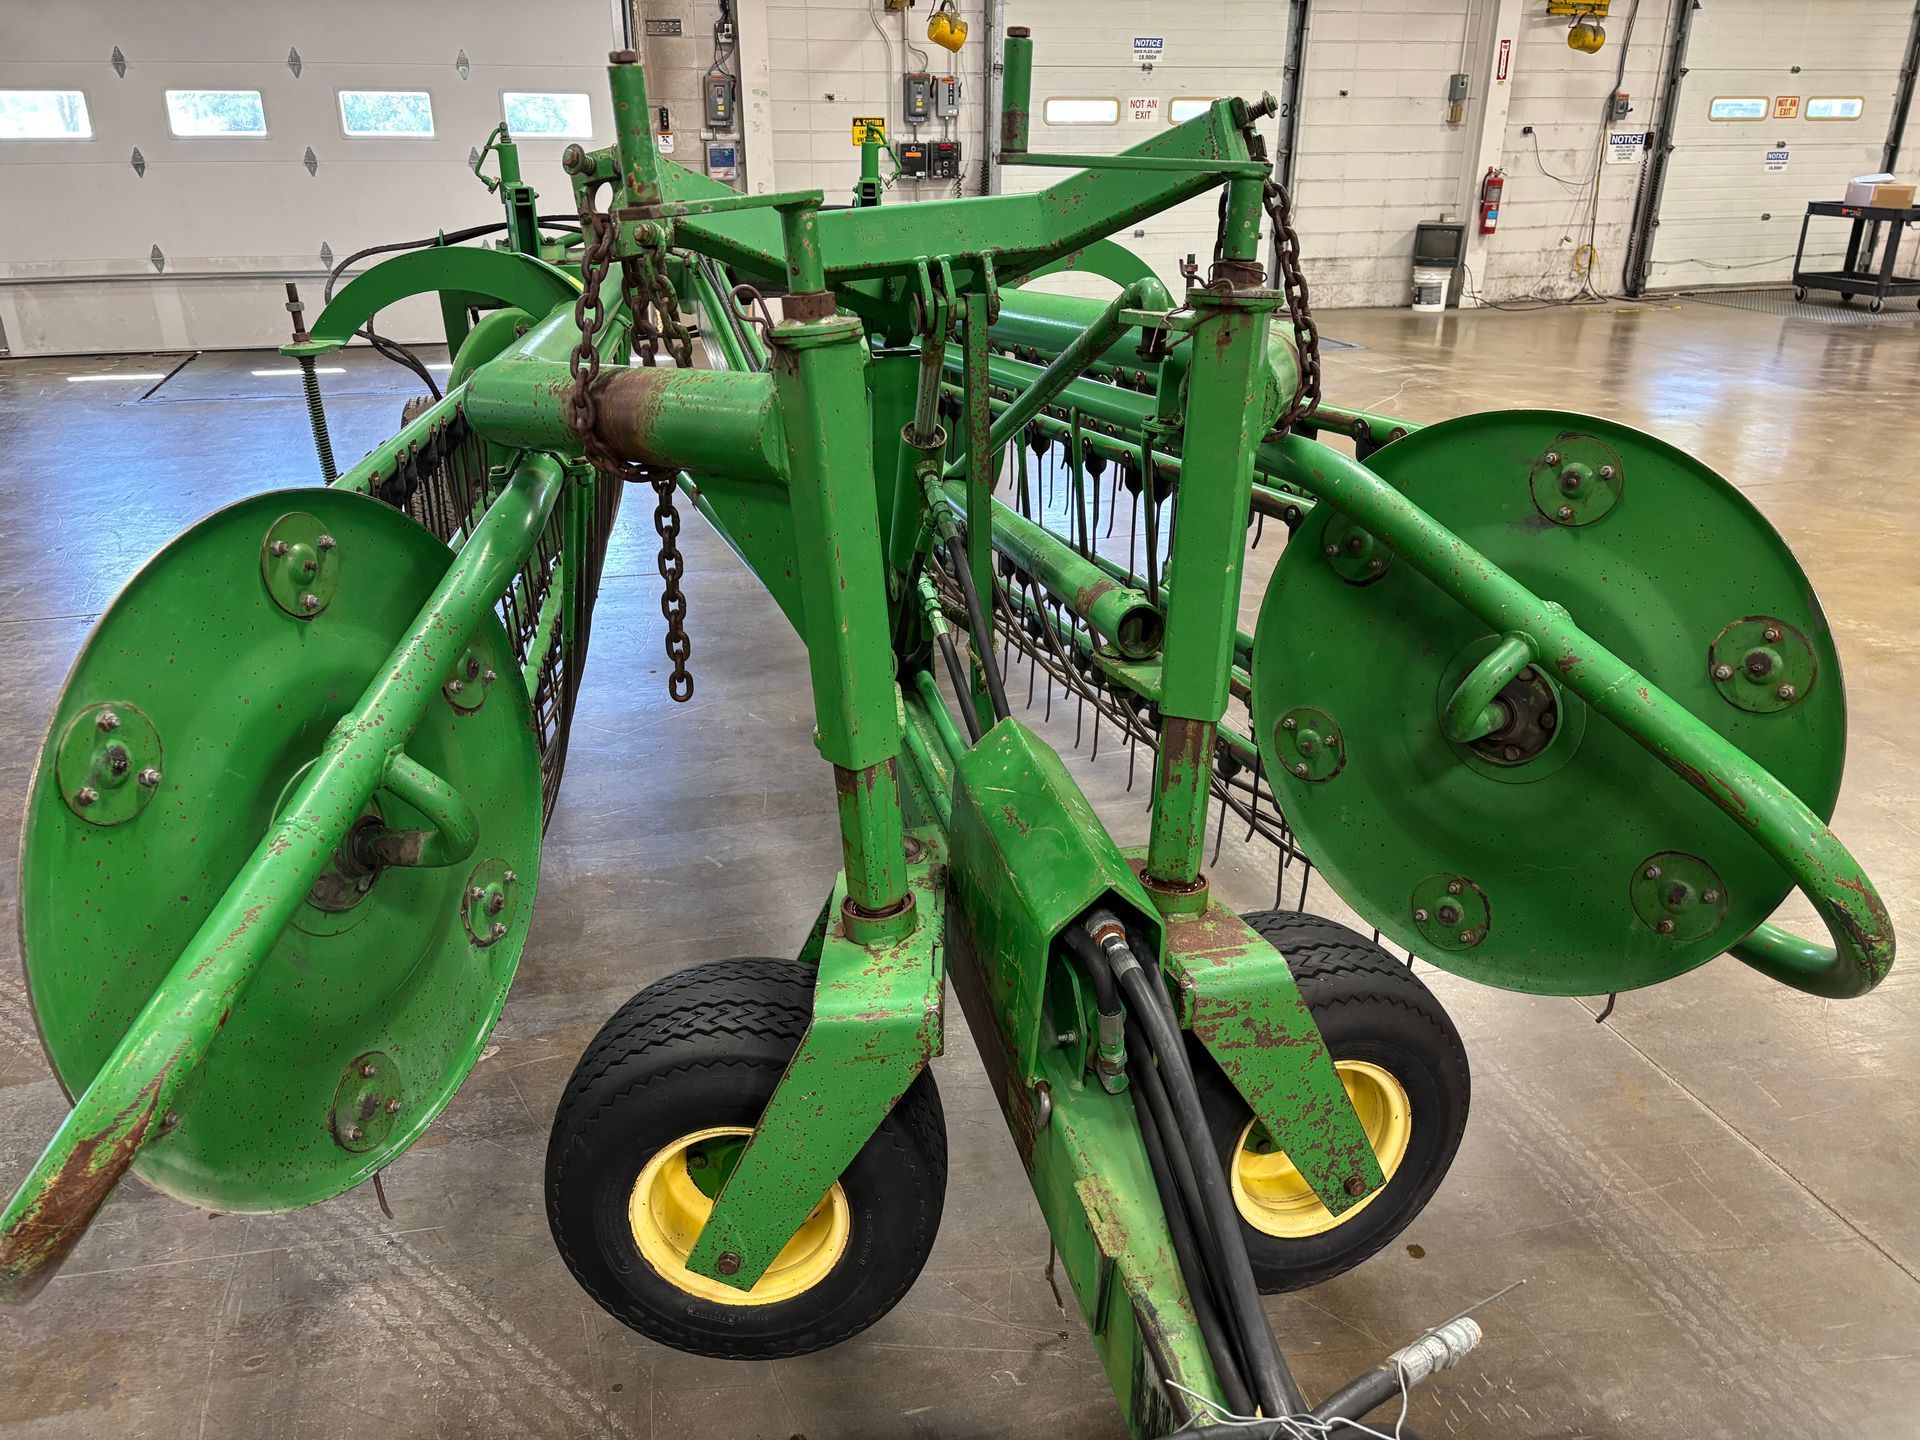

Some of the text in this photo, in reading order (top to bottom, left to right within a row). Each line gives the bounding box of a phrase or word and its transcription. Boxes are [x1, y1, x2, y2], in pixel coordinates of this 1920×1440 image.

[1135, 39, 1162, 47] NOTICE
[1130, 99, 1157, 108] NOT AN
[1778, 99, 1798, 107] NOT AN
[1282, 103, 1289, 117] 2
[1779, 108, 1792, 116] EXIT
[1135, 111, 1151, 119] EXIT
[1611, 135, 1642, 144] NOTICE
